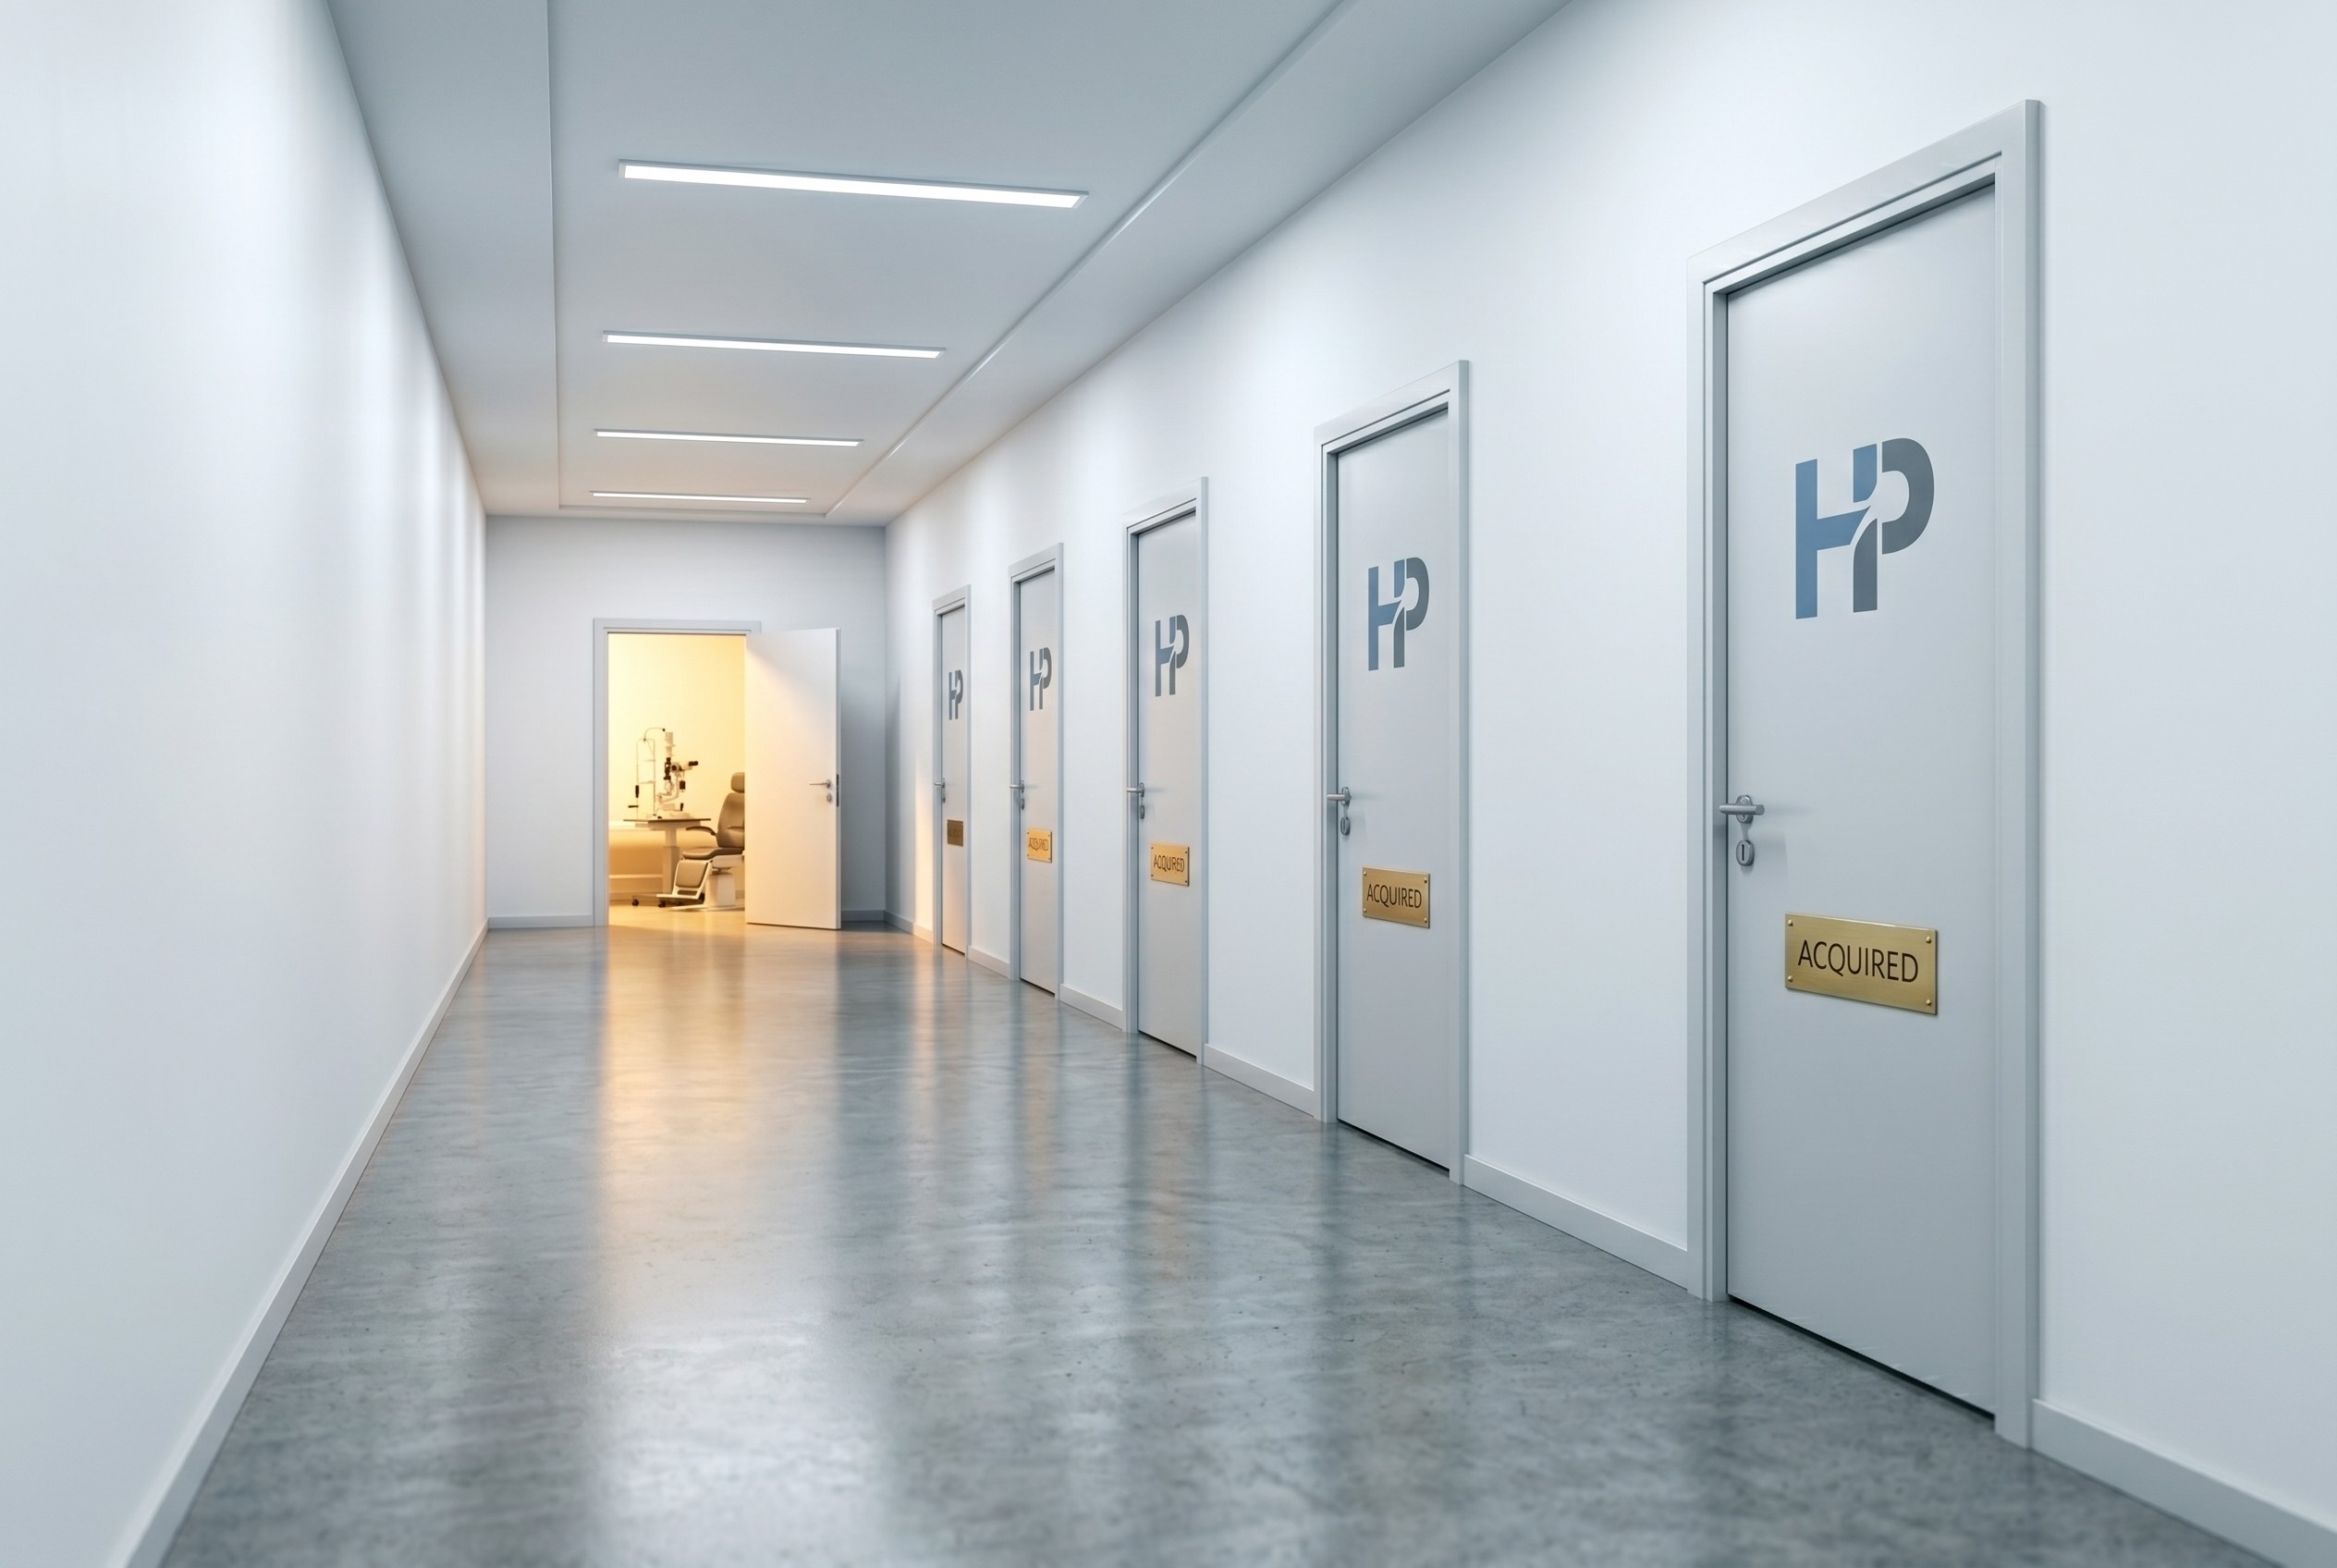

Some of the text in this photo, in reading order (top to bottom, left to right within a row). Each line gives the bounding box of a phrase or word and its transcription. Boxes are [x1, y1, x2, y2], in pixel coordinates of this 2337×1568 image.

[1795, 438, 1935, 620] HP
[1367, 557, 1430, 671] HP
[1029, 646, 1052, 712] HP
[1155, 614, 1190, 697] HP
[1366, 883, 1422, 909] ACQUIRED
[1797, 939, 1919, 984] ACQUIRED
